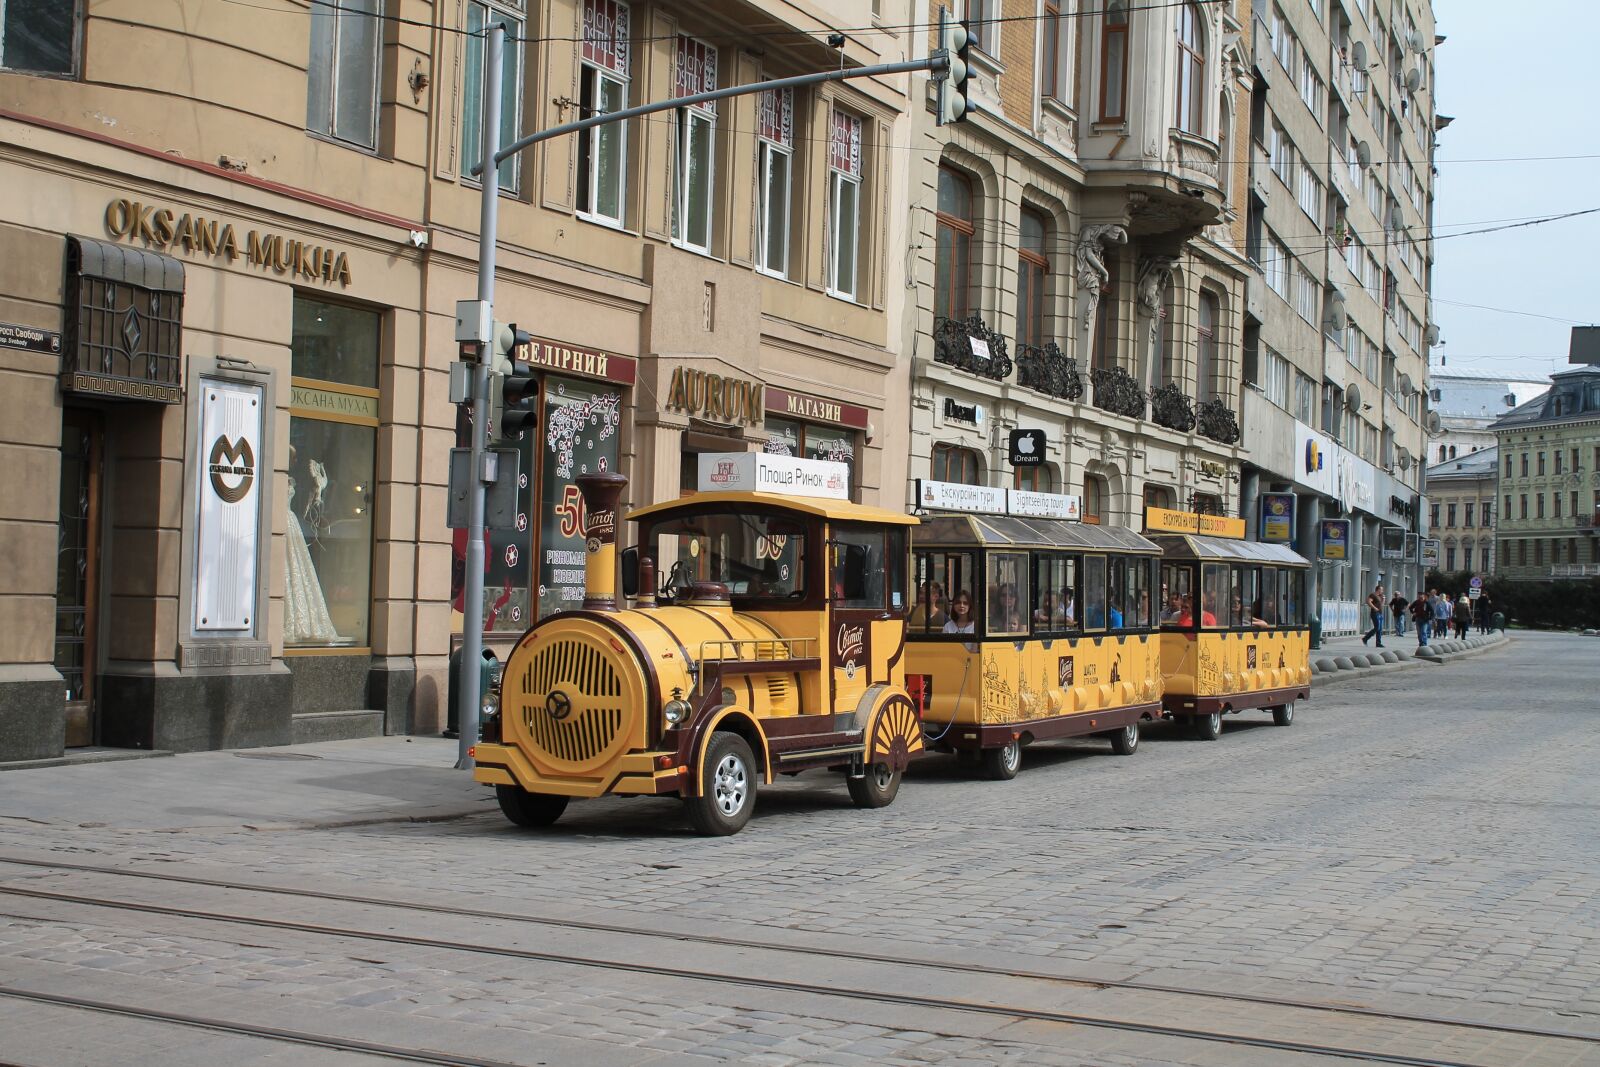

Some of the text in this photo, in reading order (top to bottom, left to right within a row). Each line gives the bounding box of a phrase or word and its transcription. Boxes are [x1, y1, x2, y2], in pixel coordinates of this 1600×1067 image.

[583, 24, 615, 56] OSTEL
[676, 68, 703, 94] OSTEL
[106, 198, 352, 286] OKSANA MUKHA
[16, 328, 44, 341] Свободи
[517, 341, 608, 377] ВЕЛІРНИЙ
[337, 397, 369, 414] МУХА
[665, 366, 763, 426] AURUM
[787, 394, 842, 422] МАГАЗИН
[1014, 454, 1039, 462] iDream
[759, 464, 793, 487] Площа
[796, 468, 823, 487] Ринок
[940, 483, 995, 507] Екскурсійні тури
[1016, 492, 1050, 510] Sightseeing
